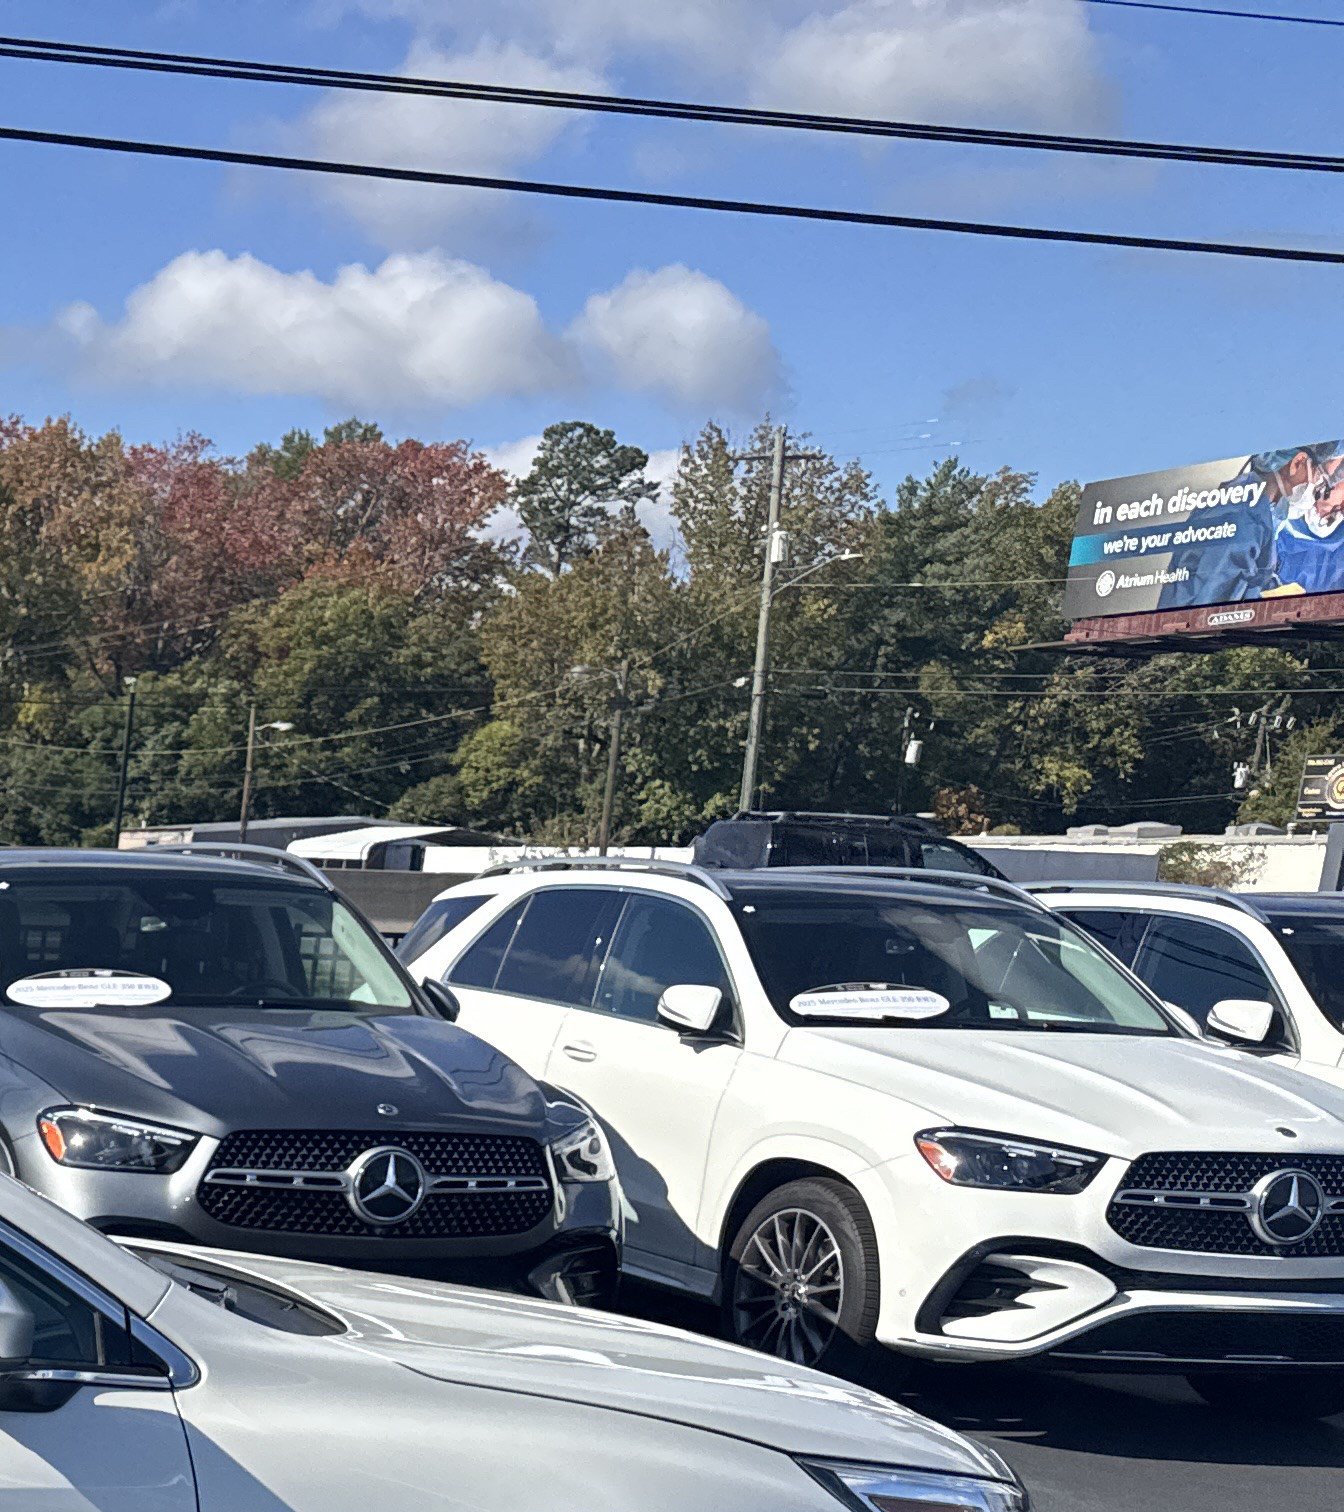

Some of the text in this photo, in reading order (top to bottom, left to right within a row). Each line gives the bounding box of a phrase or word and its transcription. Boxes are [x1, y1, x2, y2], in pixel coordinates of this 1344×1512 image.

[1093, 481, 1266, 525] in each discovery
[1104, 522, 1237, 554] we're your advocate
